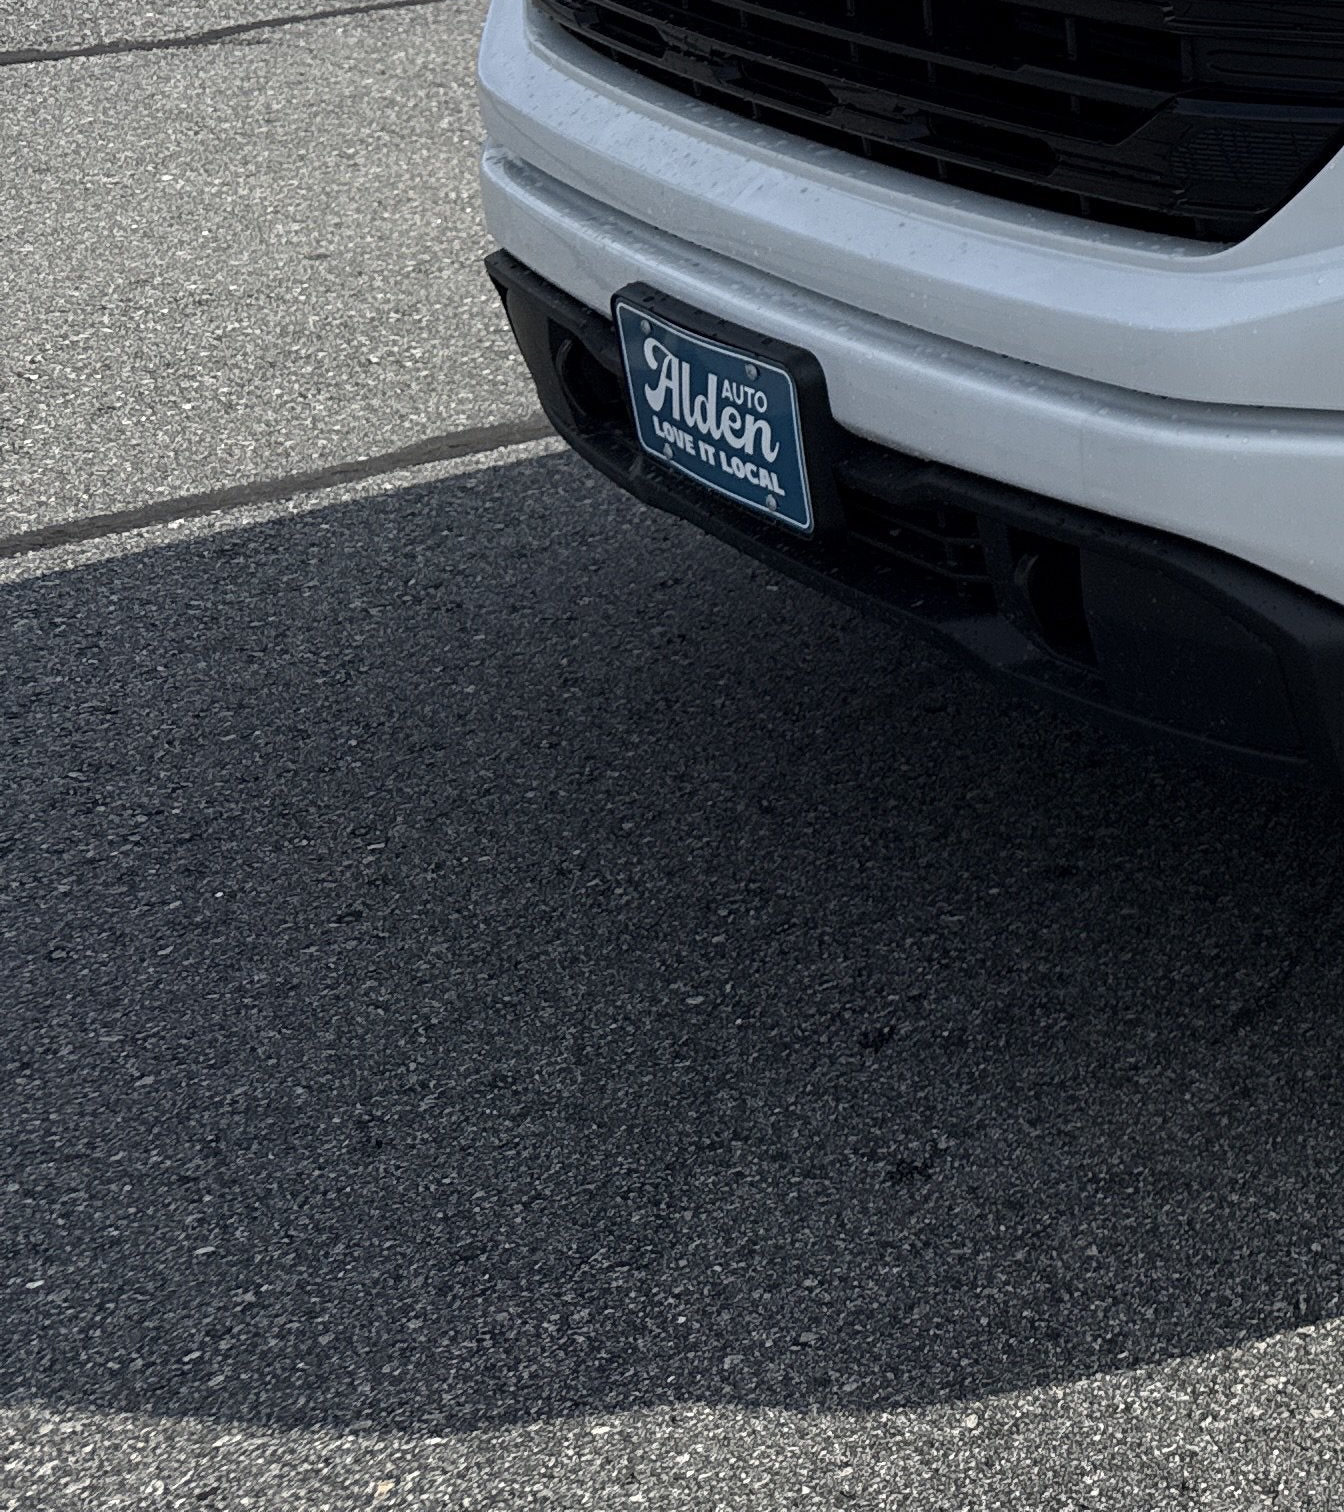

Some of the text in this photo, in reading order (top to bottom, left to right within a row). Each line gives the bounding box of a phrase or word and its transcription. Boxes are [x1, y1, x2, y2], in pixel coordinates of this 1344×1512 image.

[643, 337, 780, 463] Alden
[721, 378, 768, 414] AUTO
[652, 414, 786, 497] LOVE IT LOCAL
